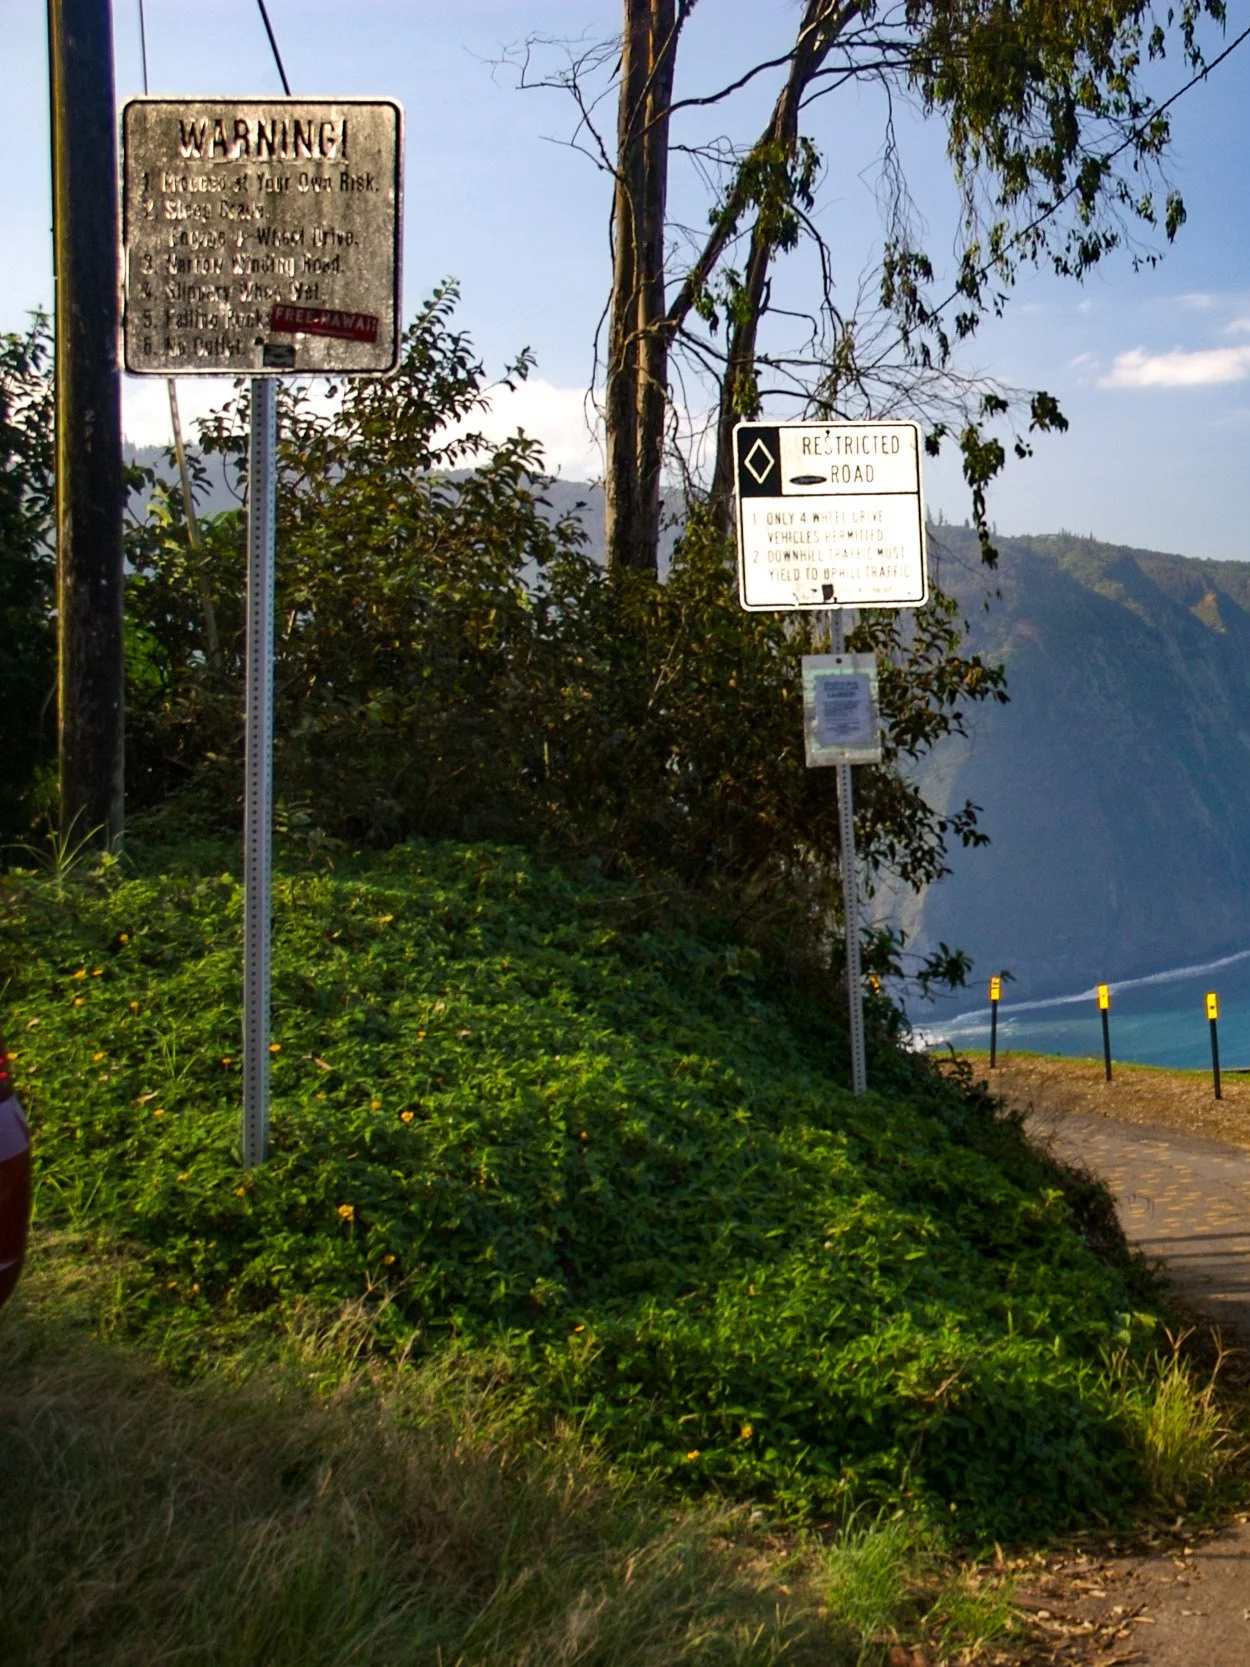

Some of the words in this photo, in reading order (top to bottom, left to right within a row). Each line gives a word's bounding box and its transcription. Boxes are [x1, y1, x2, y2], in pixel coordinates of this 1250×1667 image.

[178, 117, 349, 160] WARNING!
[256, 172, 290, 194] Your
[298, 171, 333, 193] Own
[340, 170, 380, 193] Risk.
[274, 306, 314, 323] FREE
[802, 435, 900, 456] RESTRICTED
[831, 464, 874, 484] ROAD
[766, 511, 795, 526] ONLY
[800, 511, 807, 524] 4
[767, 530, 820, 545] VEHICLES
[767, 549, 824, 563] DOWNHILL
[877, 545, 905, 560] MUST
[768, 567, 800, 582] YIELD
[806, 567, 818, 581] TO
